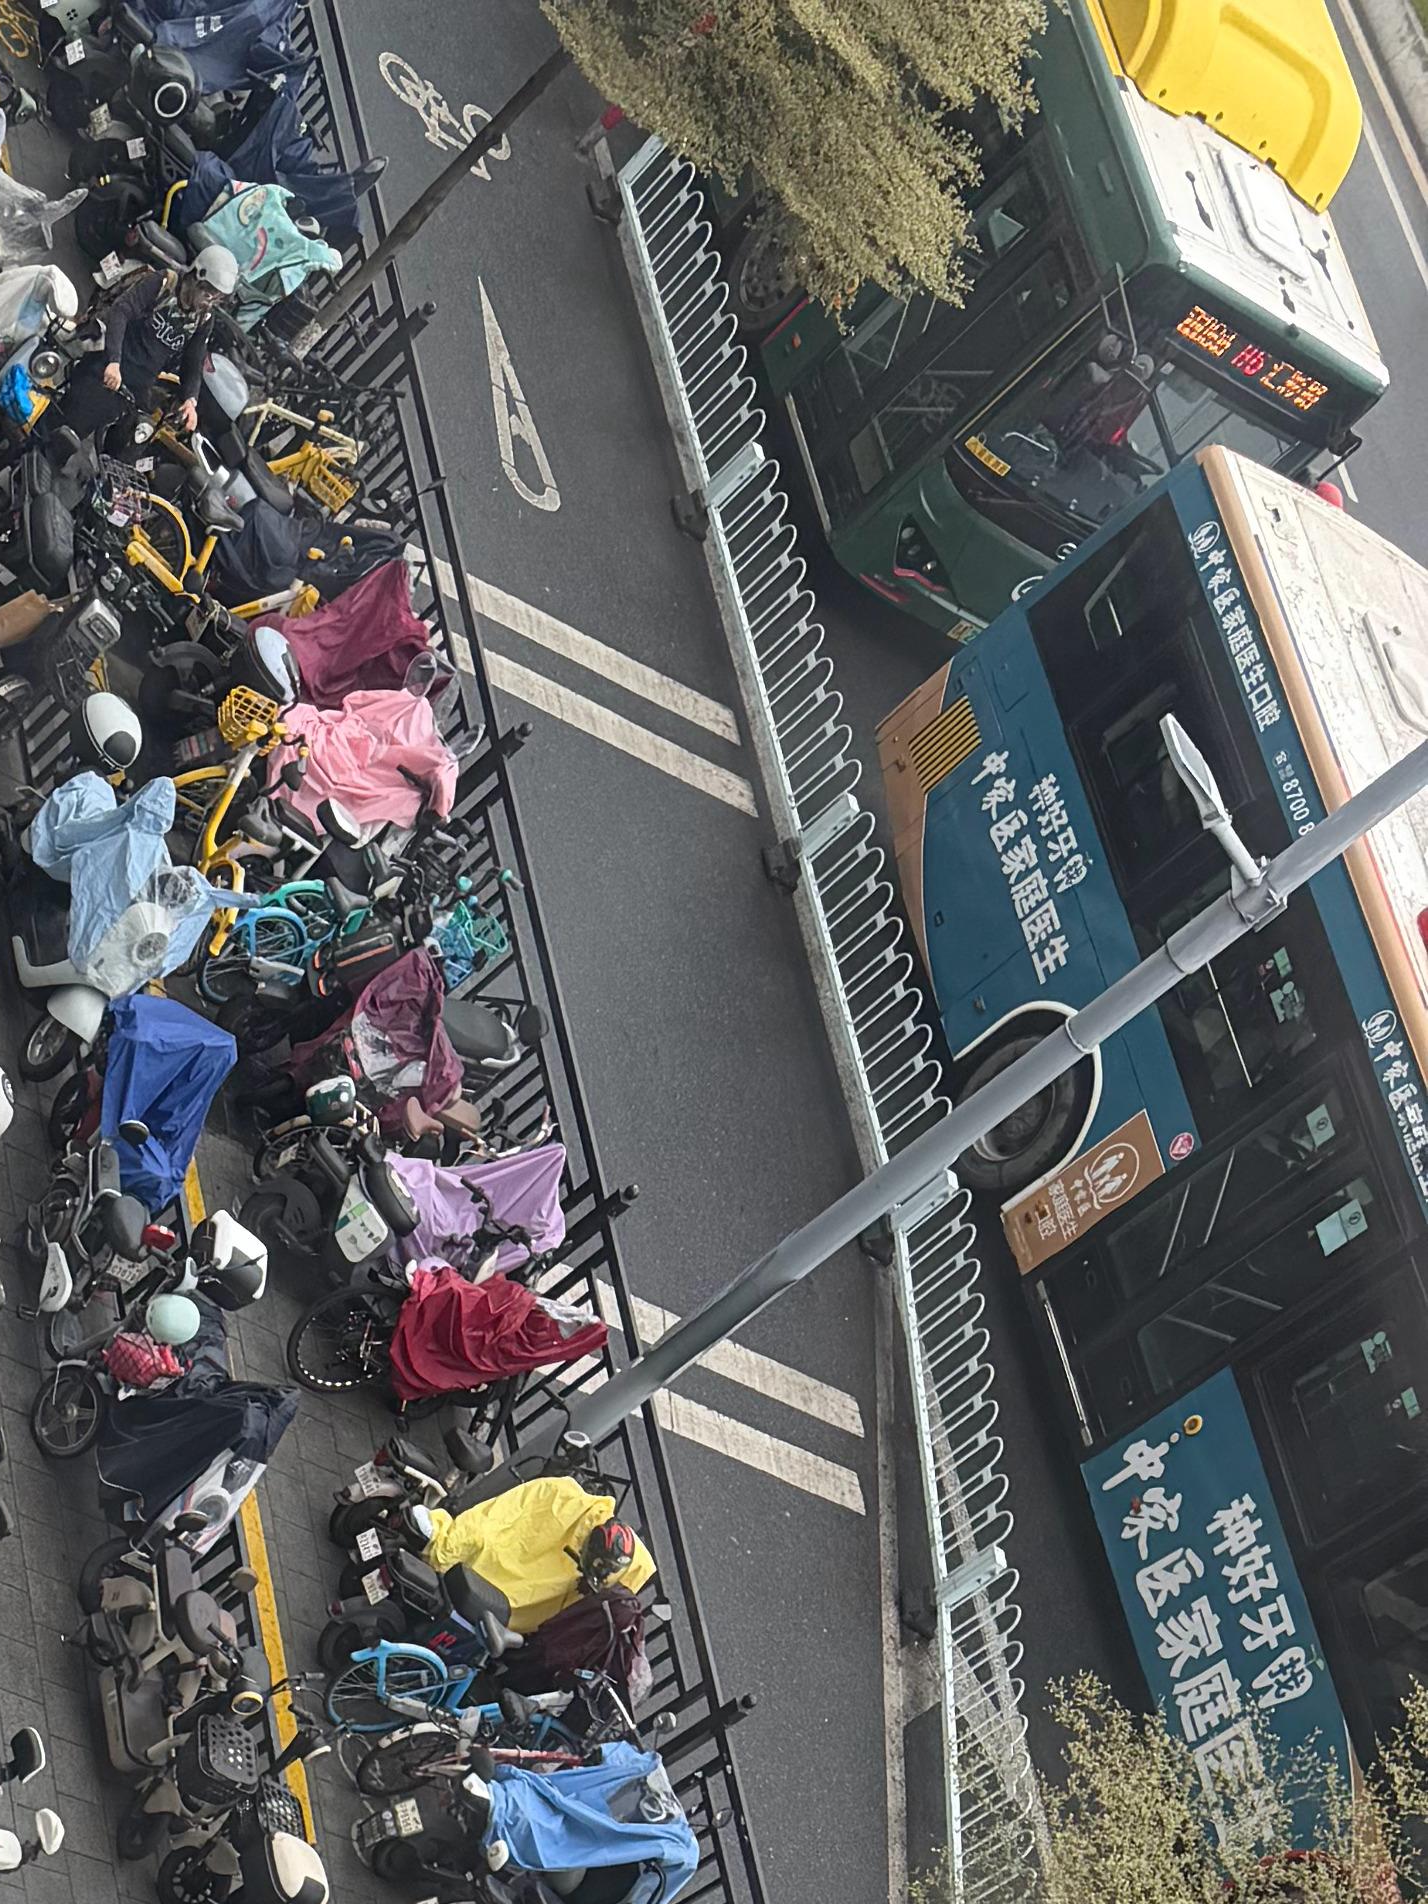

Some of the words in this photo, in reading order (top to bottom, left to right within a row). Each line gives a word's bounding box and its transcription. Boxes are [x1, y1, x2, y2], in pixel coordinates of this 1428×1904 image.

[1282, 778, 1310, 822] 8700
[970, 750, 1072, 985] 中家医家庭医生
[1050, 1180, 1078, 1240] 家庭医生
